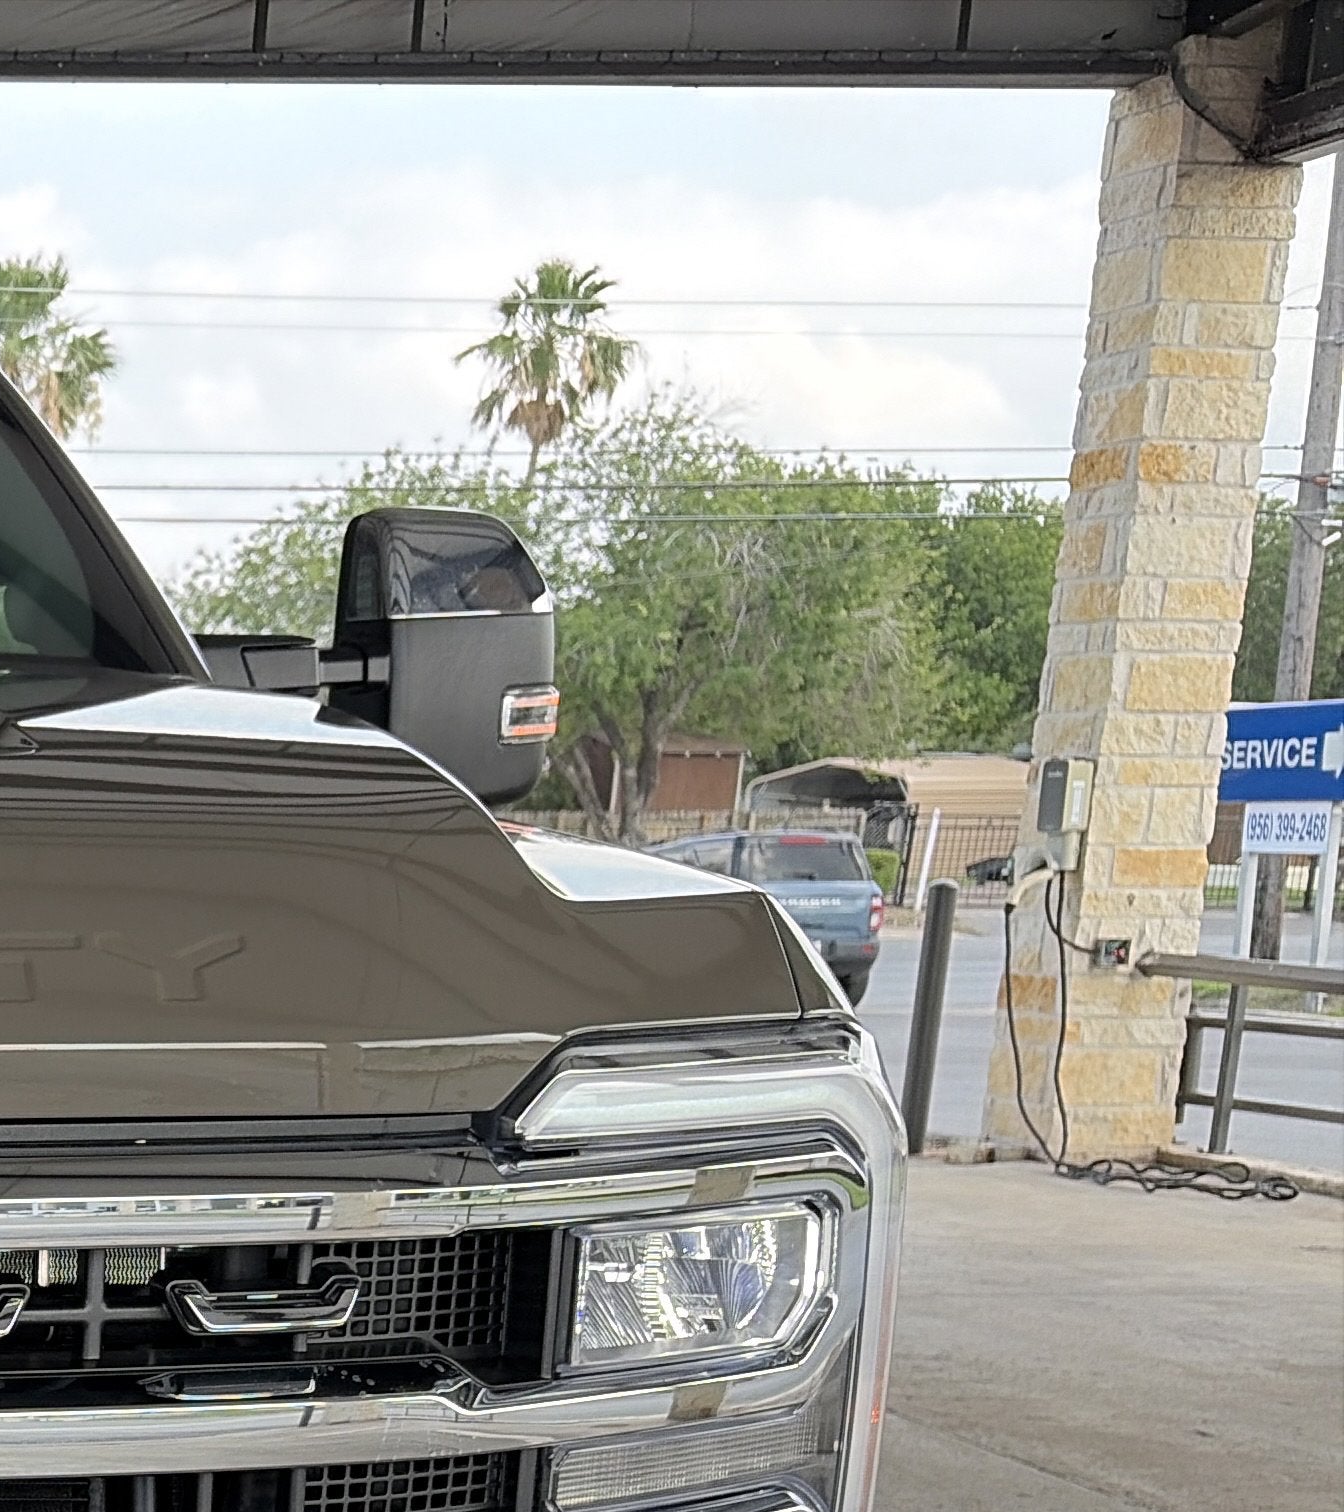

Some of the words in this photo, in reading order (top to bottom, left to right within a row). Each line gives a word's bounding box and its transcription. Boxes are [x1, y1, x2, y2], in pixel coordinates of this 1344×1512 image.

[1221, 736, 1318, 770] SERVICE
[1246, 812, 1274, 841] (956)
[1275, 812, 1328, 841] 399-2468
